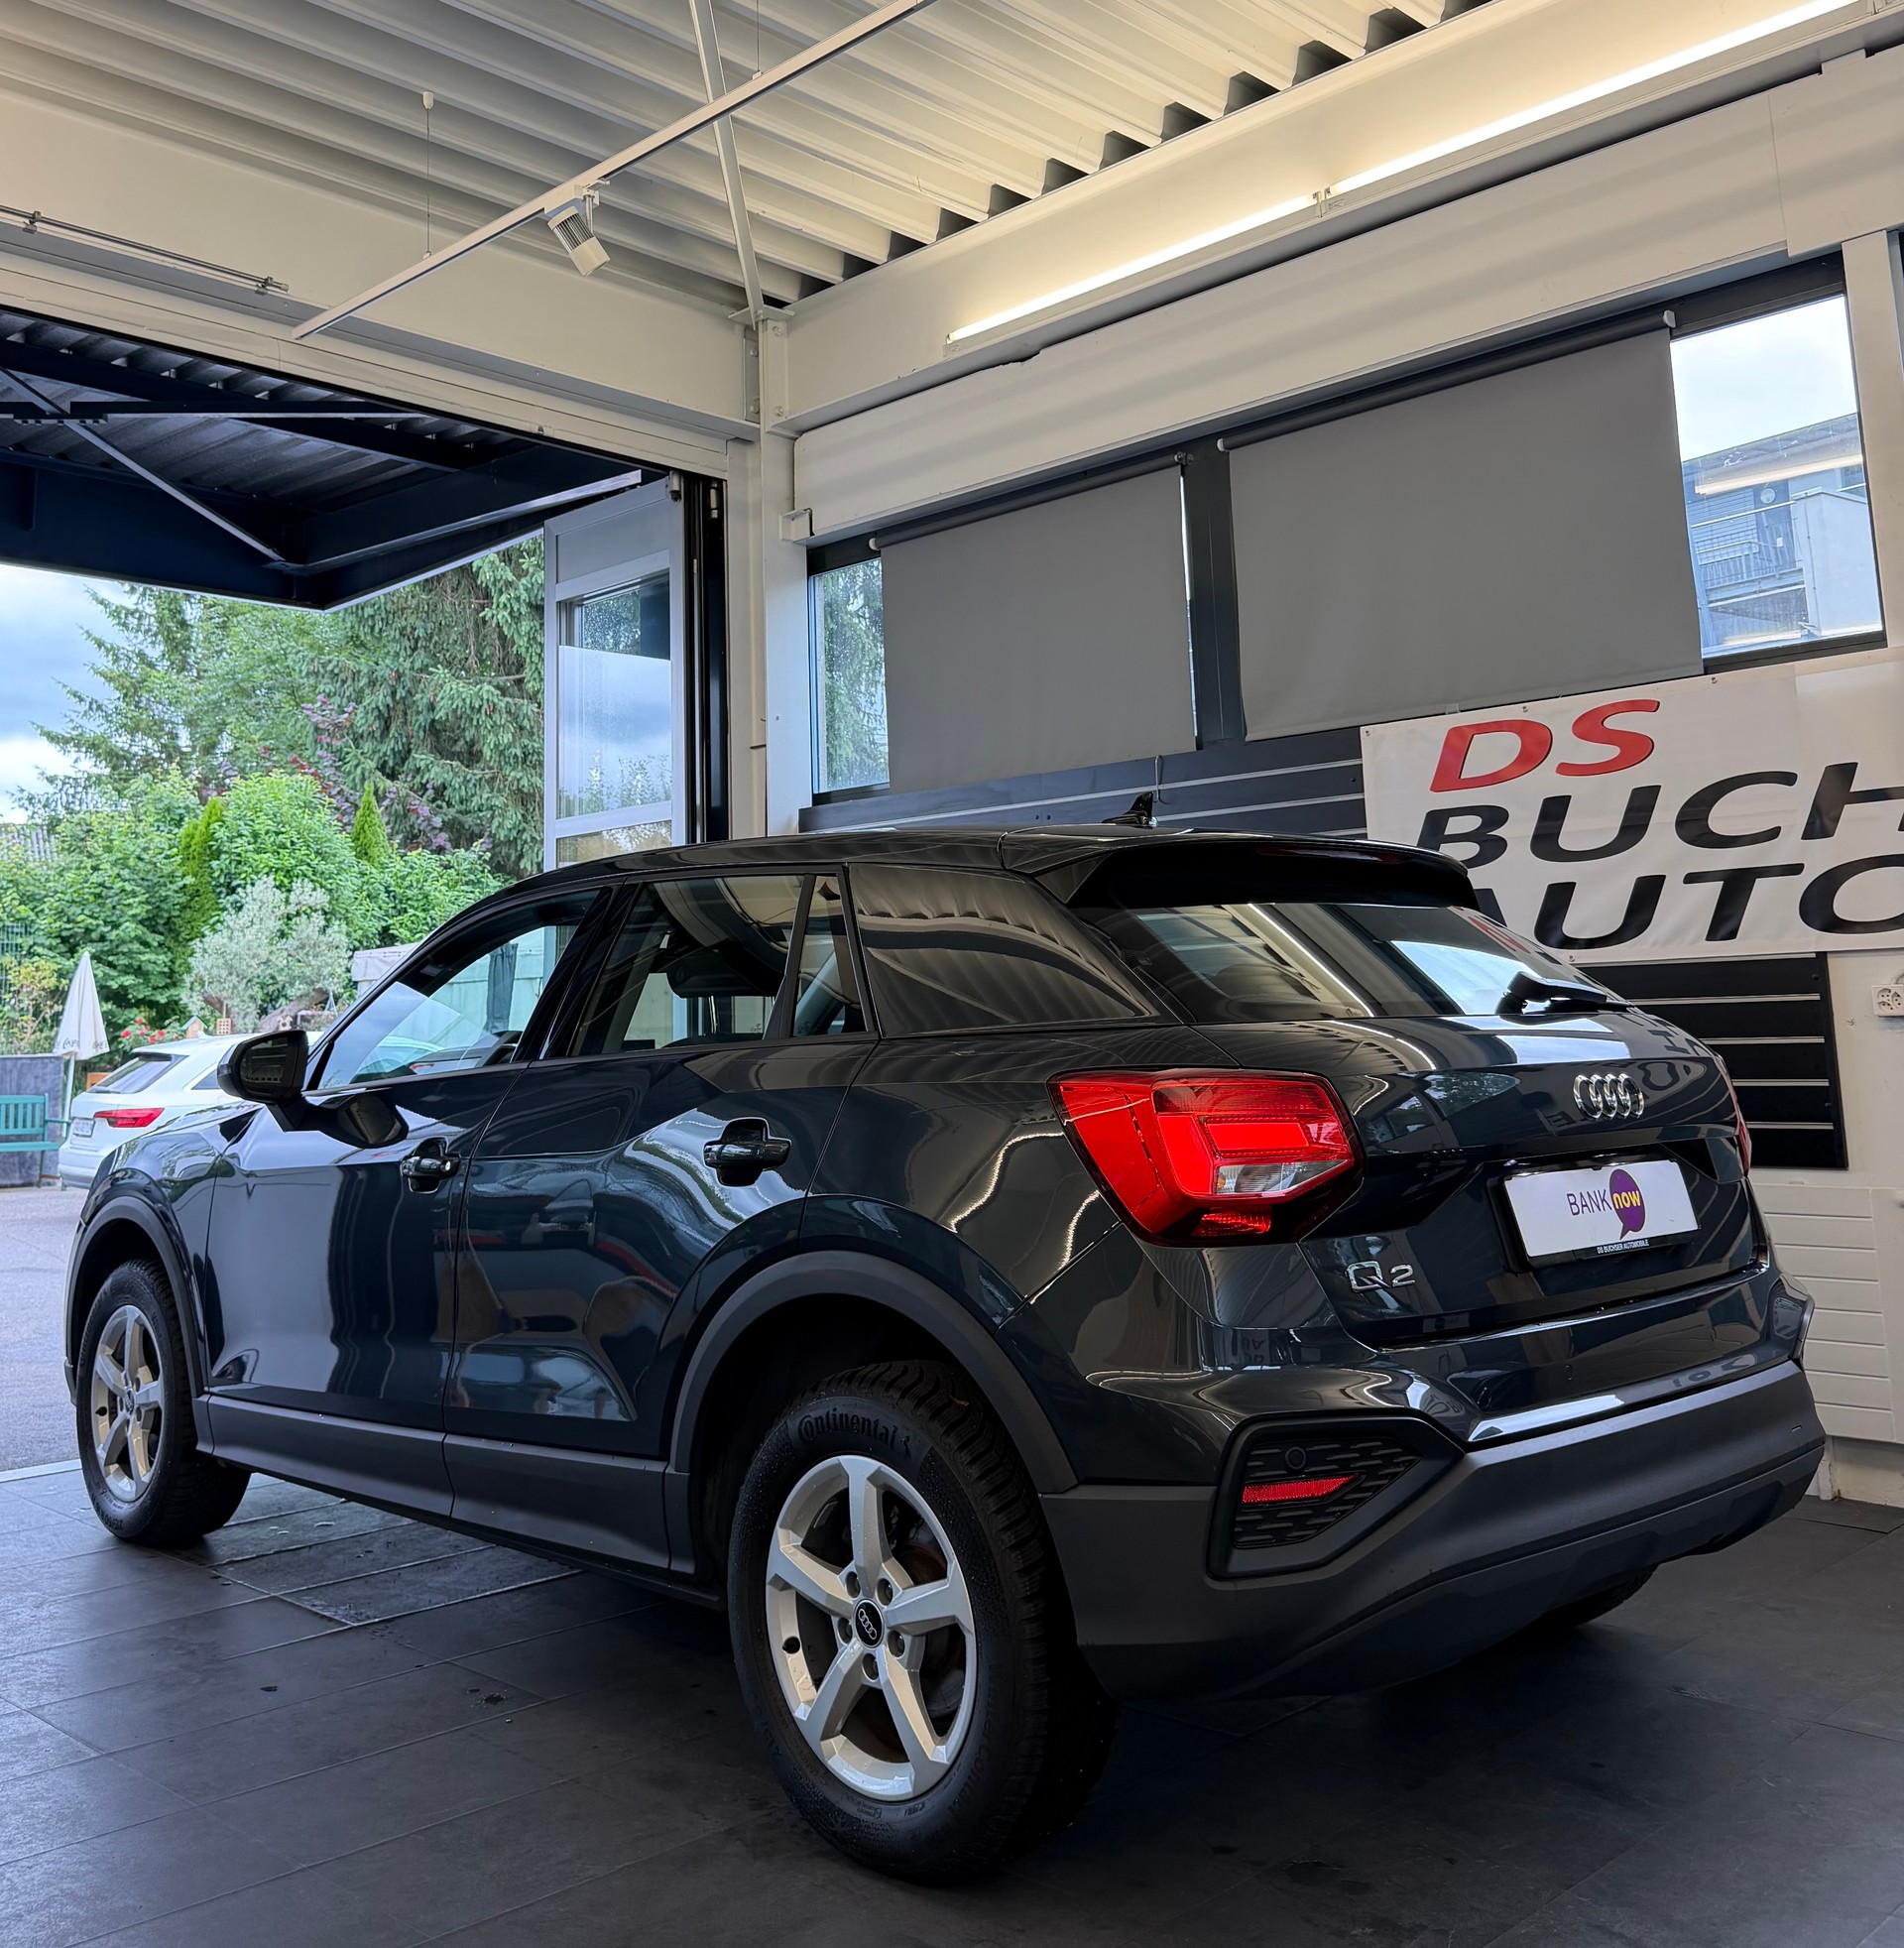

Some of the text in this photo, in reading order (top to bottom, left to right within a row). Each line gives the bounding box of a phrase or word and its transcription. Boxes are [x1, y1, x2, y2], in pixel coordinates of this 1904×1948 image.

[1430, 699, 1661, 792] DS
[1566, 1189, 1641, 1216] BANK now
[1623, 1239, 1650, 1250] AUTOMOBILE
[1347, 1261, 1415, 1290] Q2
[797, 1407, 898, 1451] Continental
